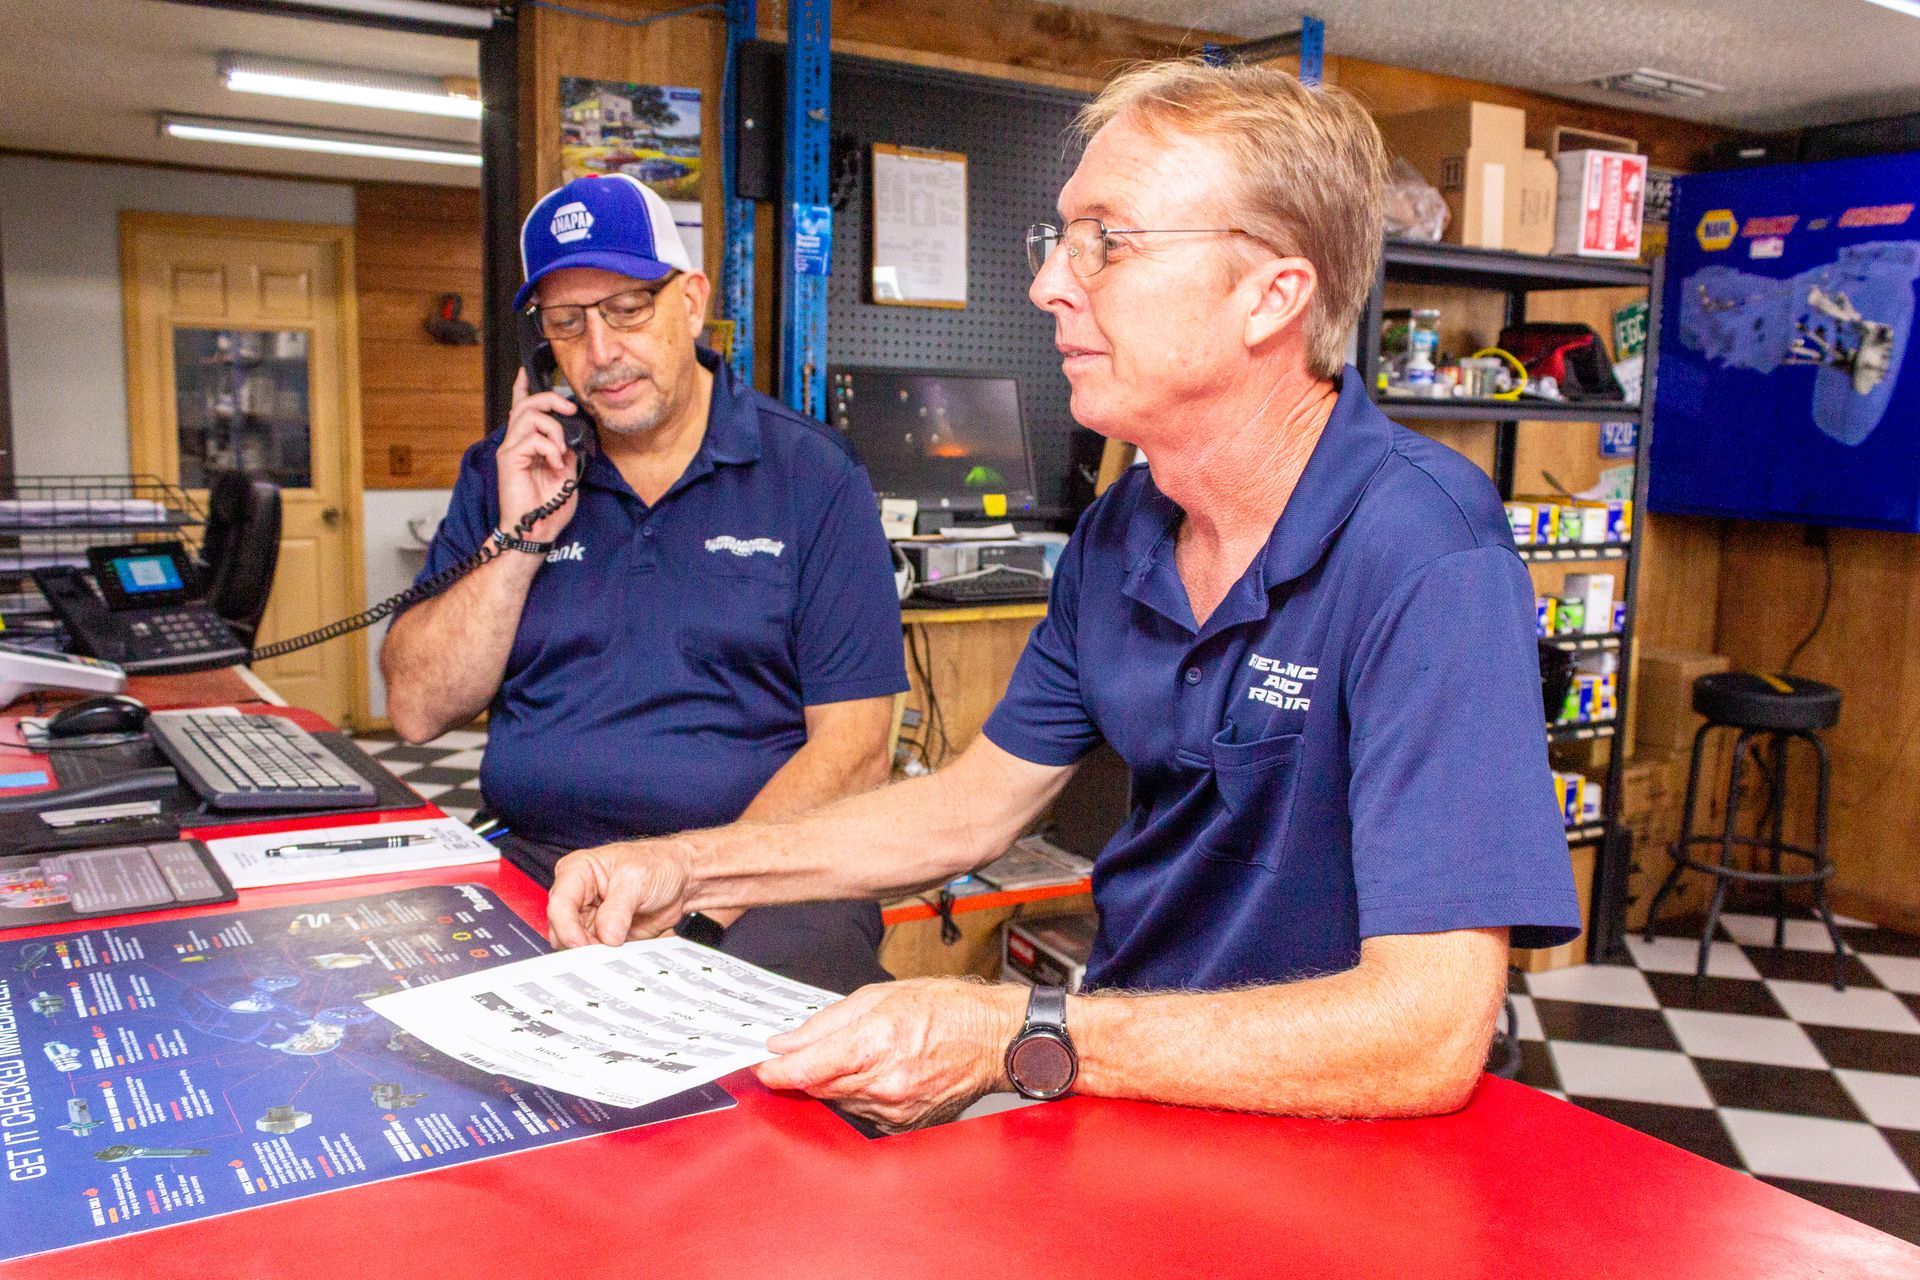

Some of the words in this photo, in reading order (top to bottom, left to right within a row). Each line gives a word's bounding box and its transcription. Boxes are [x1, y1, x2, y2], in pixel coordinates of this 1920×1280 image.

[556, 211, 588, 235] NAPA
[546, 541, 586, 563] ank
[0, 1059, 36, 1127] CHECKED
[4, 1130, 39, 1146] IT
[7, 1148, 47, 1181] GET
